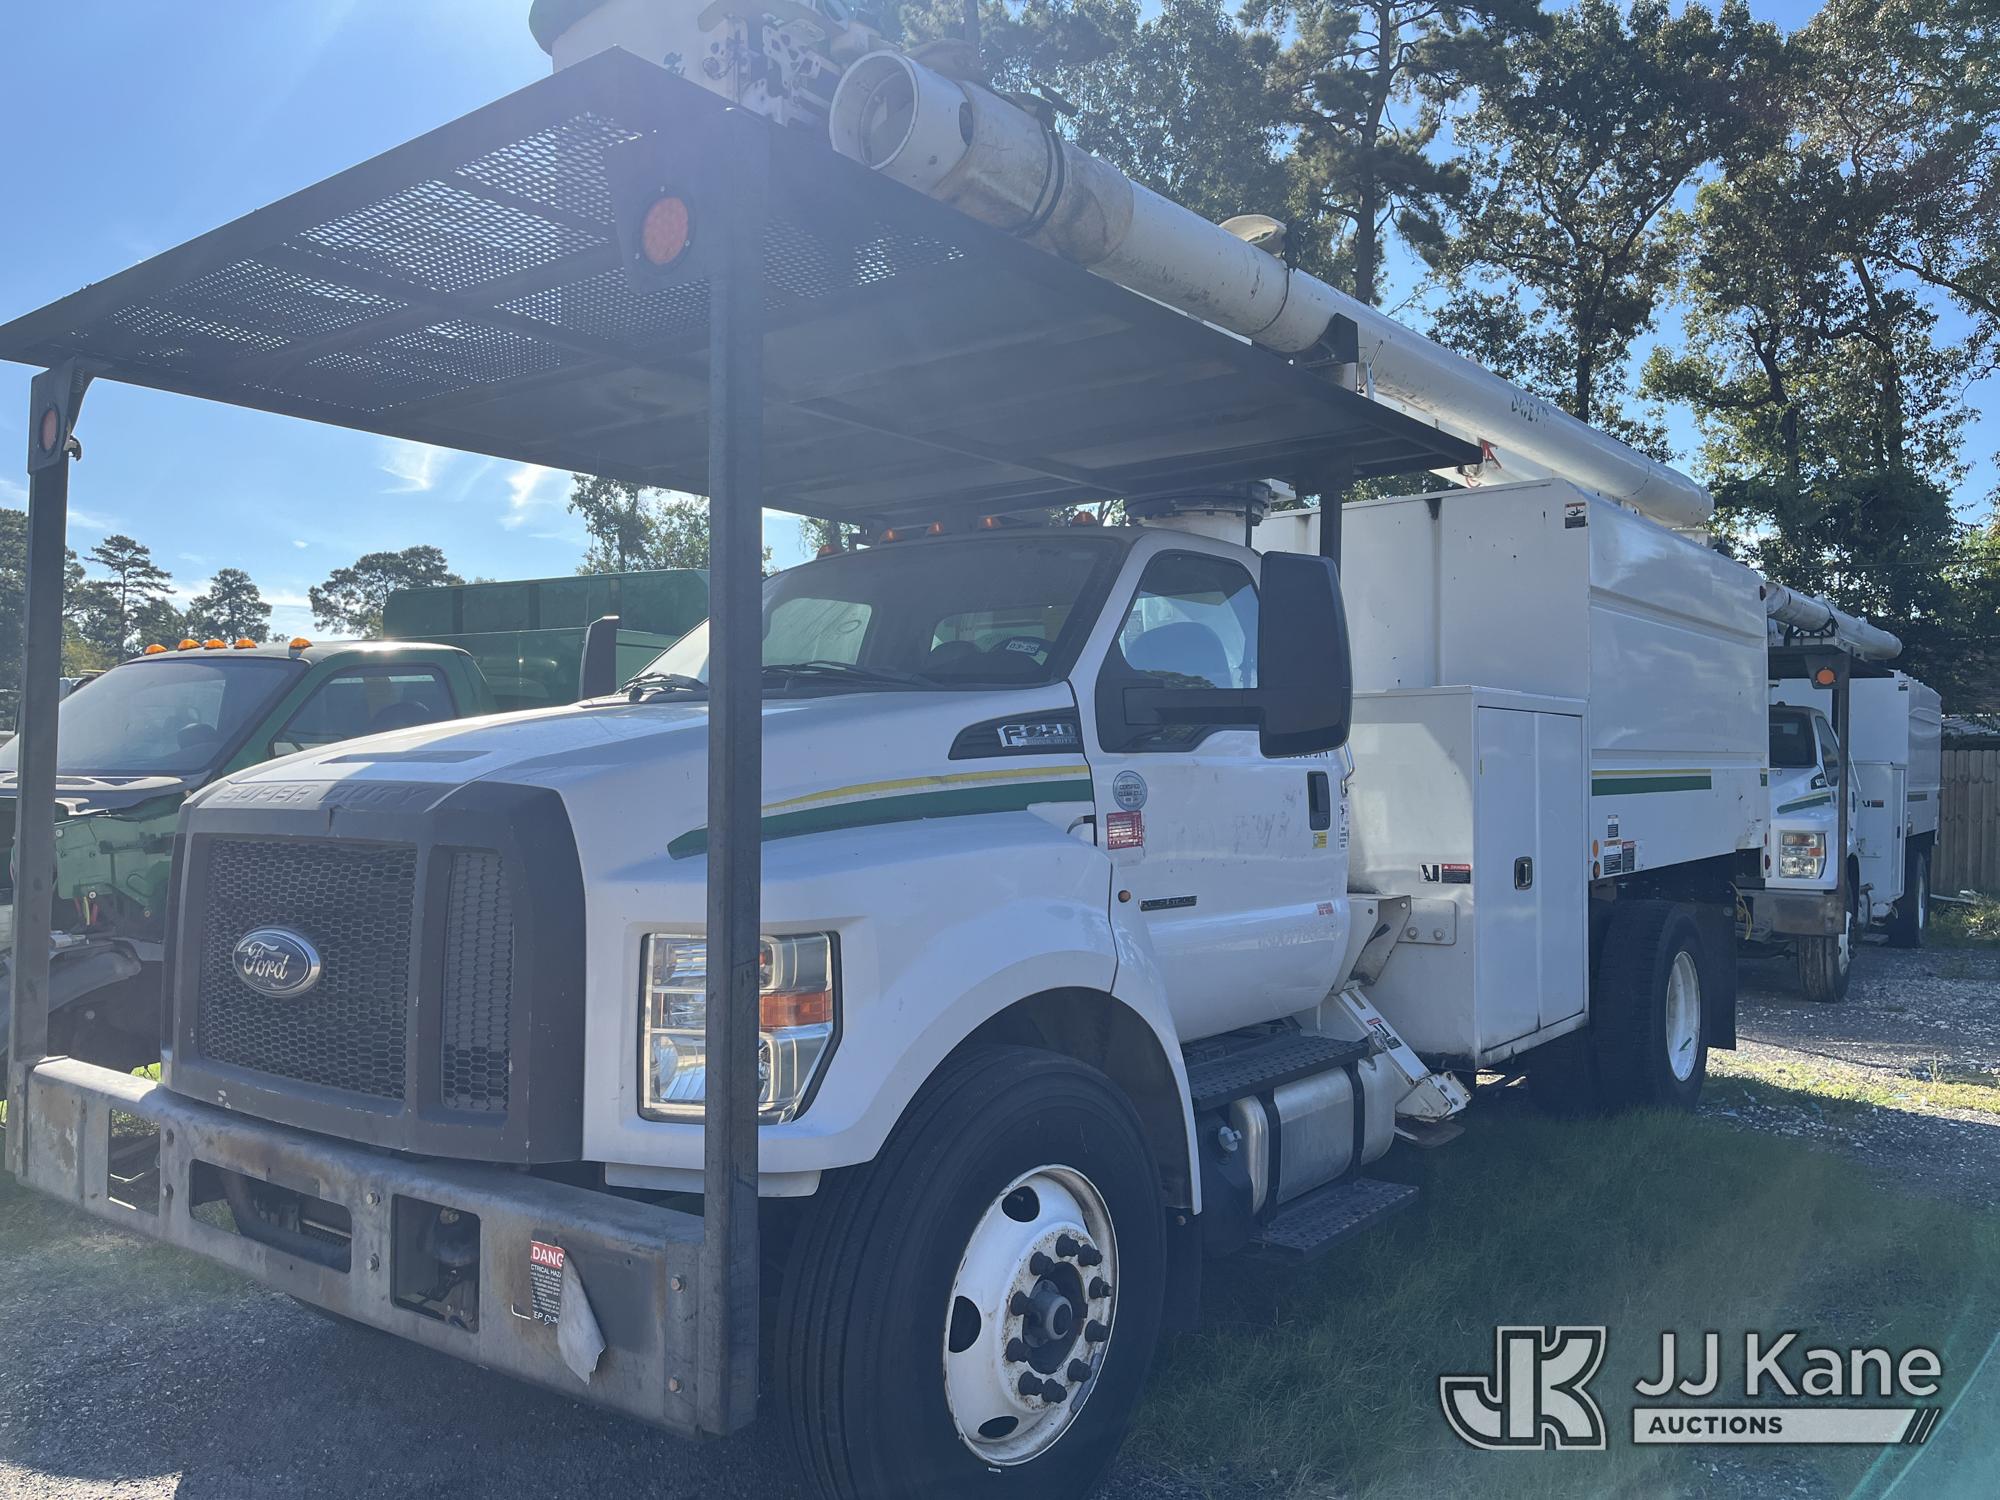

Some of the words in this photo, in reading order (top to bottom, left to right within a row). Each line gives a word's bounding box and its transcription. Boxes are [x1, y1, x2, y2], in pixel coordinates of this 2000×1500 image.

[217, 785, 318, 803] SUPER
[319, 785, 432, 805] DUTY
[243, 941, 290, 980] Ford
